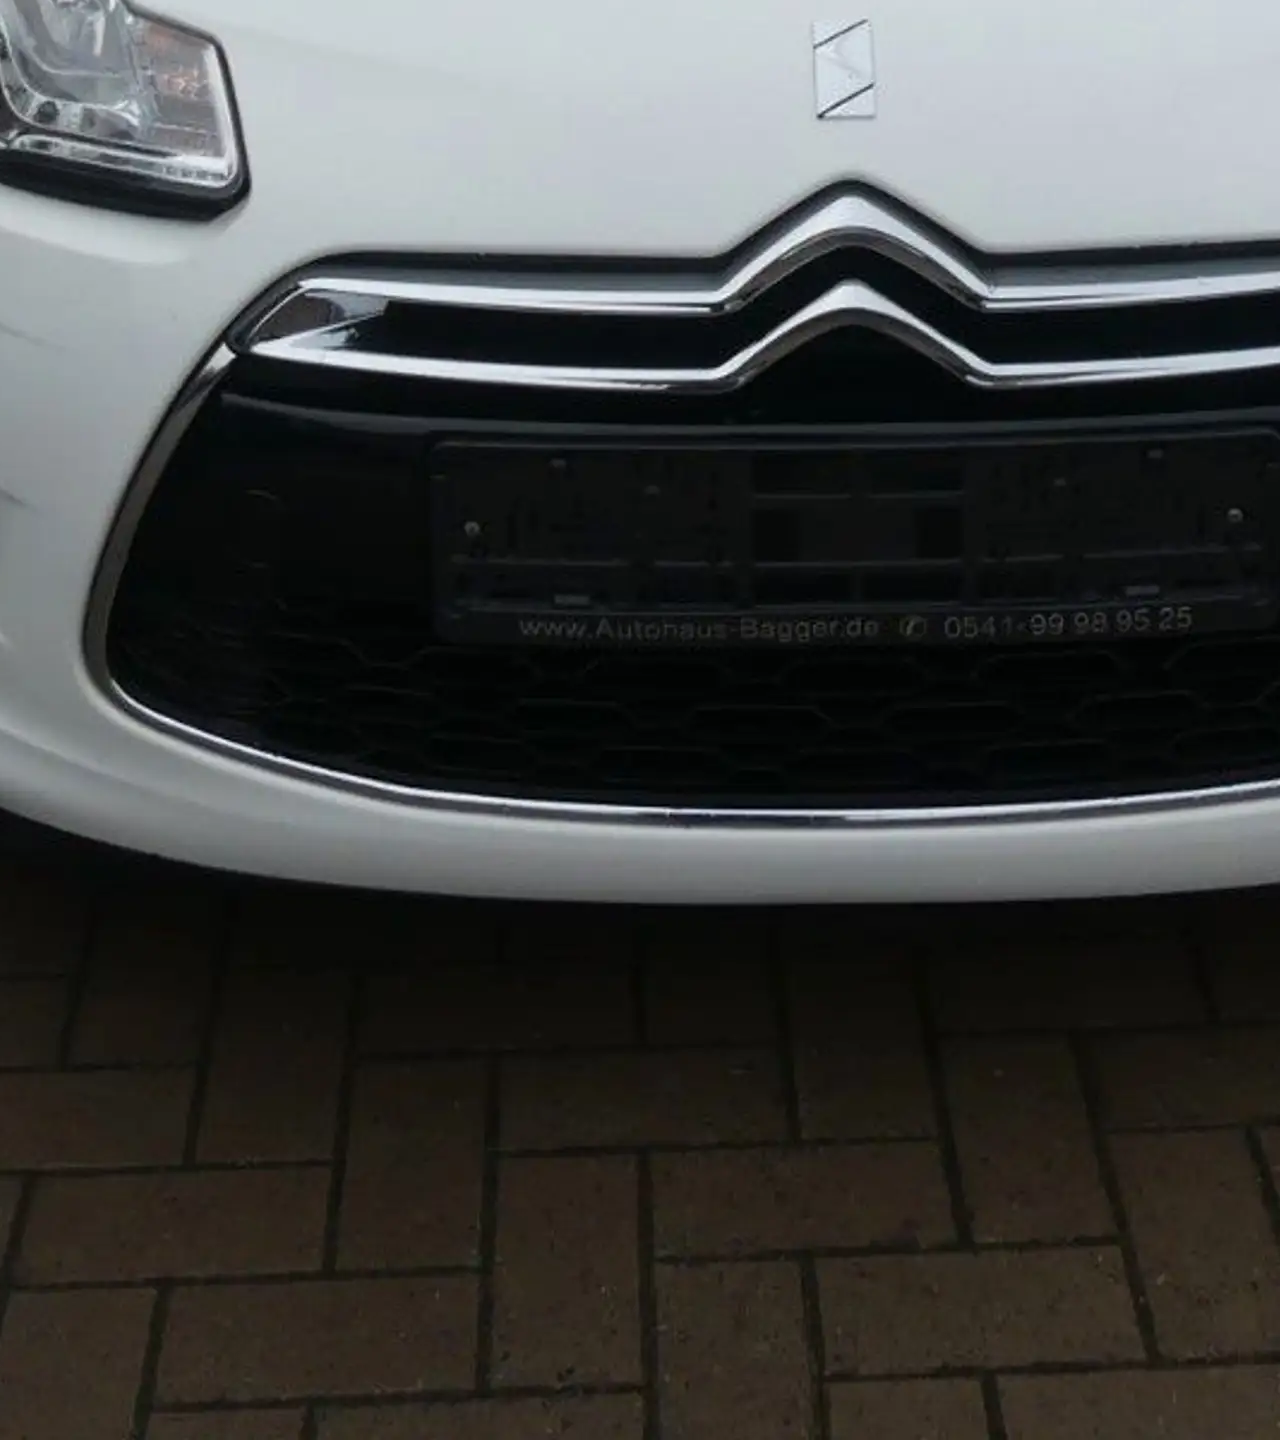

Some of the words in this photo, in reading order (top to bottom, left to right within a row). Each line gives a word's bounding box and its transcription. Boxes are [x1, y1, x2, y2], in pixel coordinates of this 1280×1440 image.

[518, 616, 882, 641] www.Autohaus-Bagger.de
[1116, 609, 1150, 633] 95
[1158, 606, 1193, 631] 25
